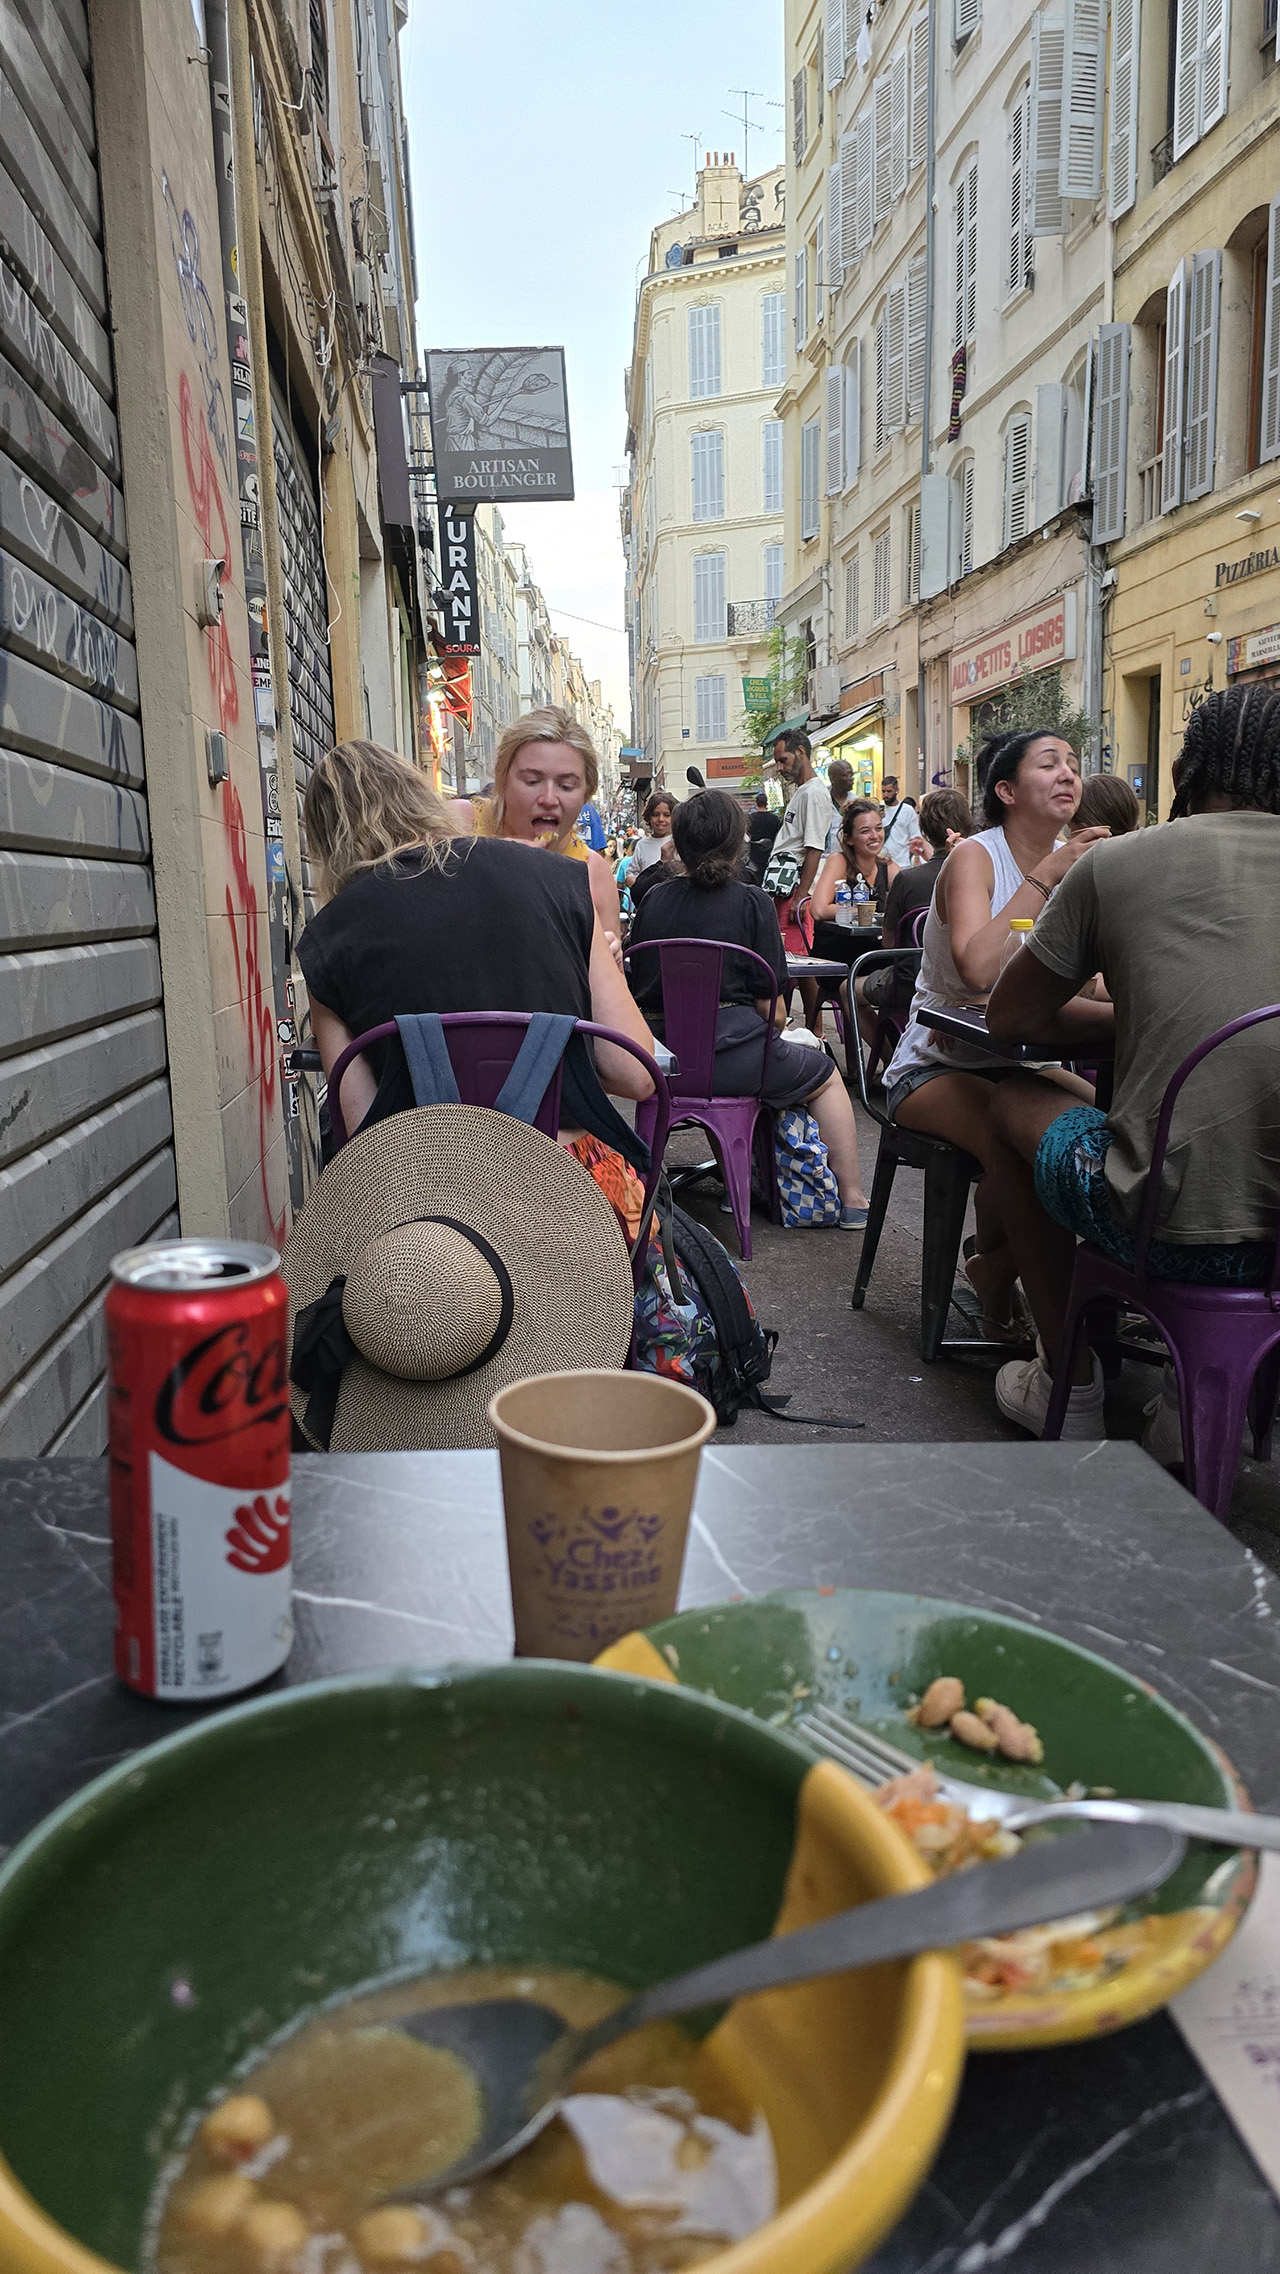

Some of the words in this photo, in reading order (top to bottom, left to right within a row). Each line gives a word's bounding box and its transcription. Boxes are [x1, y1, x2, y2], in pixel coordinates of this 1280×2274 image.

[469, 459, 540, 474] ARTISAN
[453, 473, 557, 489] BOULANGER
[952, 659, 971, 692] AUX
[975, 640, 1011, 681] PETITS
[1018, 614, 1063, 662] LOISIRS
[746, 685, 769, 693] JACQUES
[567, 1538, 643, 1568] Chez
[544, 1552, 662, 1592] Yassine
